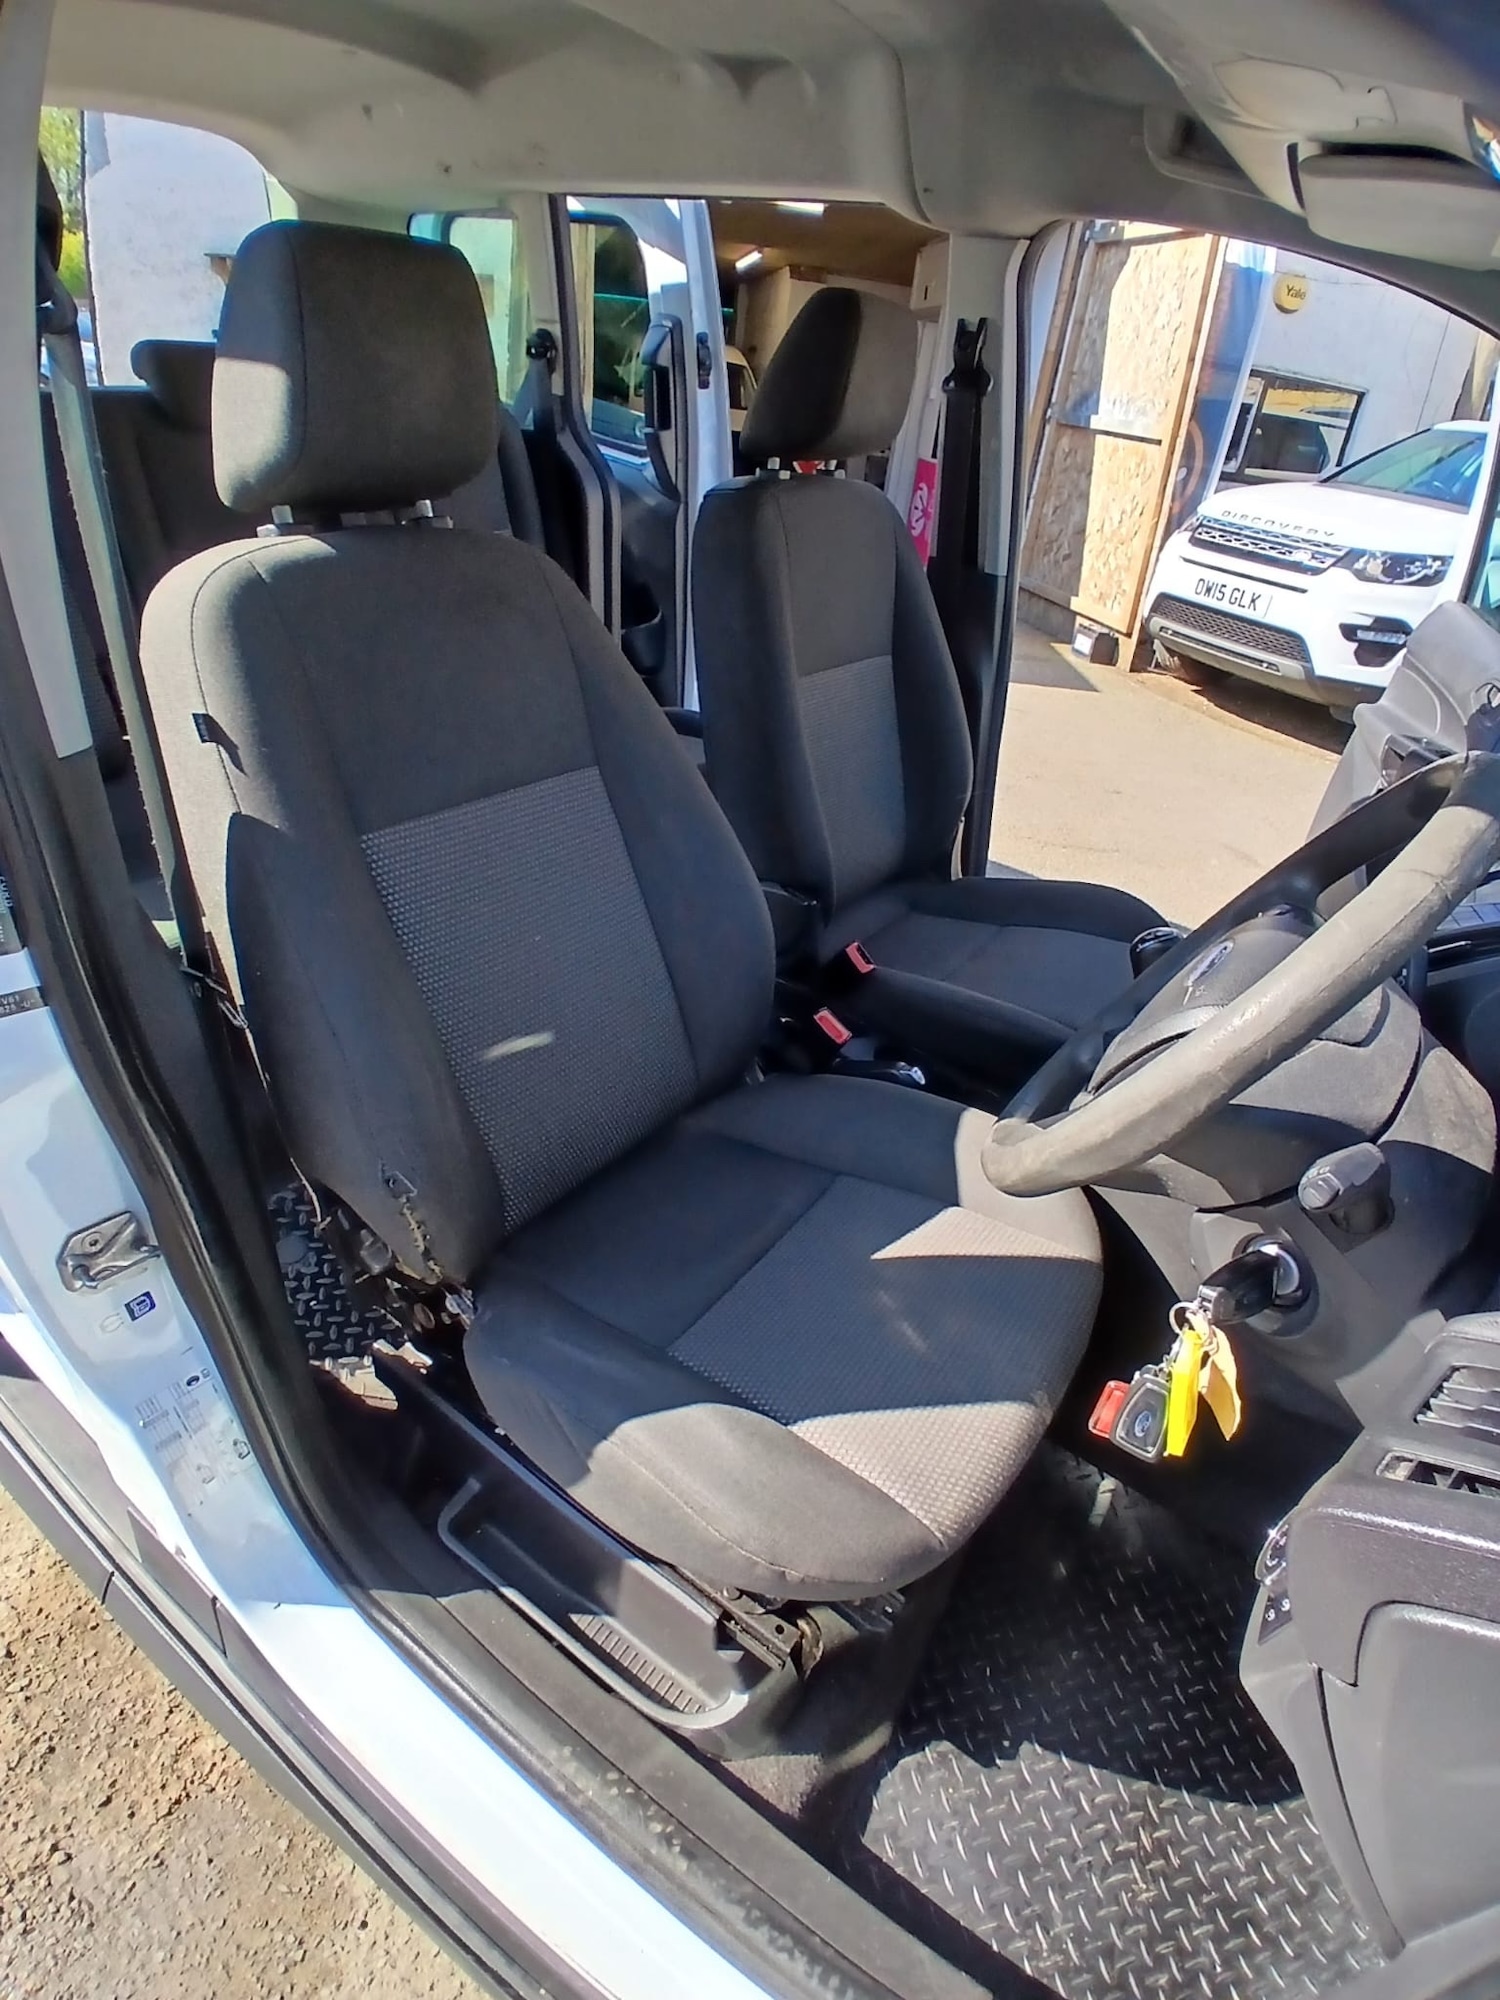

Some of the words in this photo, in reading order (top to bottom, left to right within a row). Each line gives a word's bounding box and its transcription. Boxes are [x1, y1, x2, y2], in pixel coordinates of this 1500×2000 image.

[1286, 284, 1307, 301] Yale
[1221, 510, 1335, 537] DISCOVERY
[1228, 587, 1262, 612] GLK
